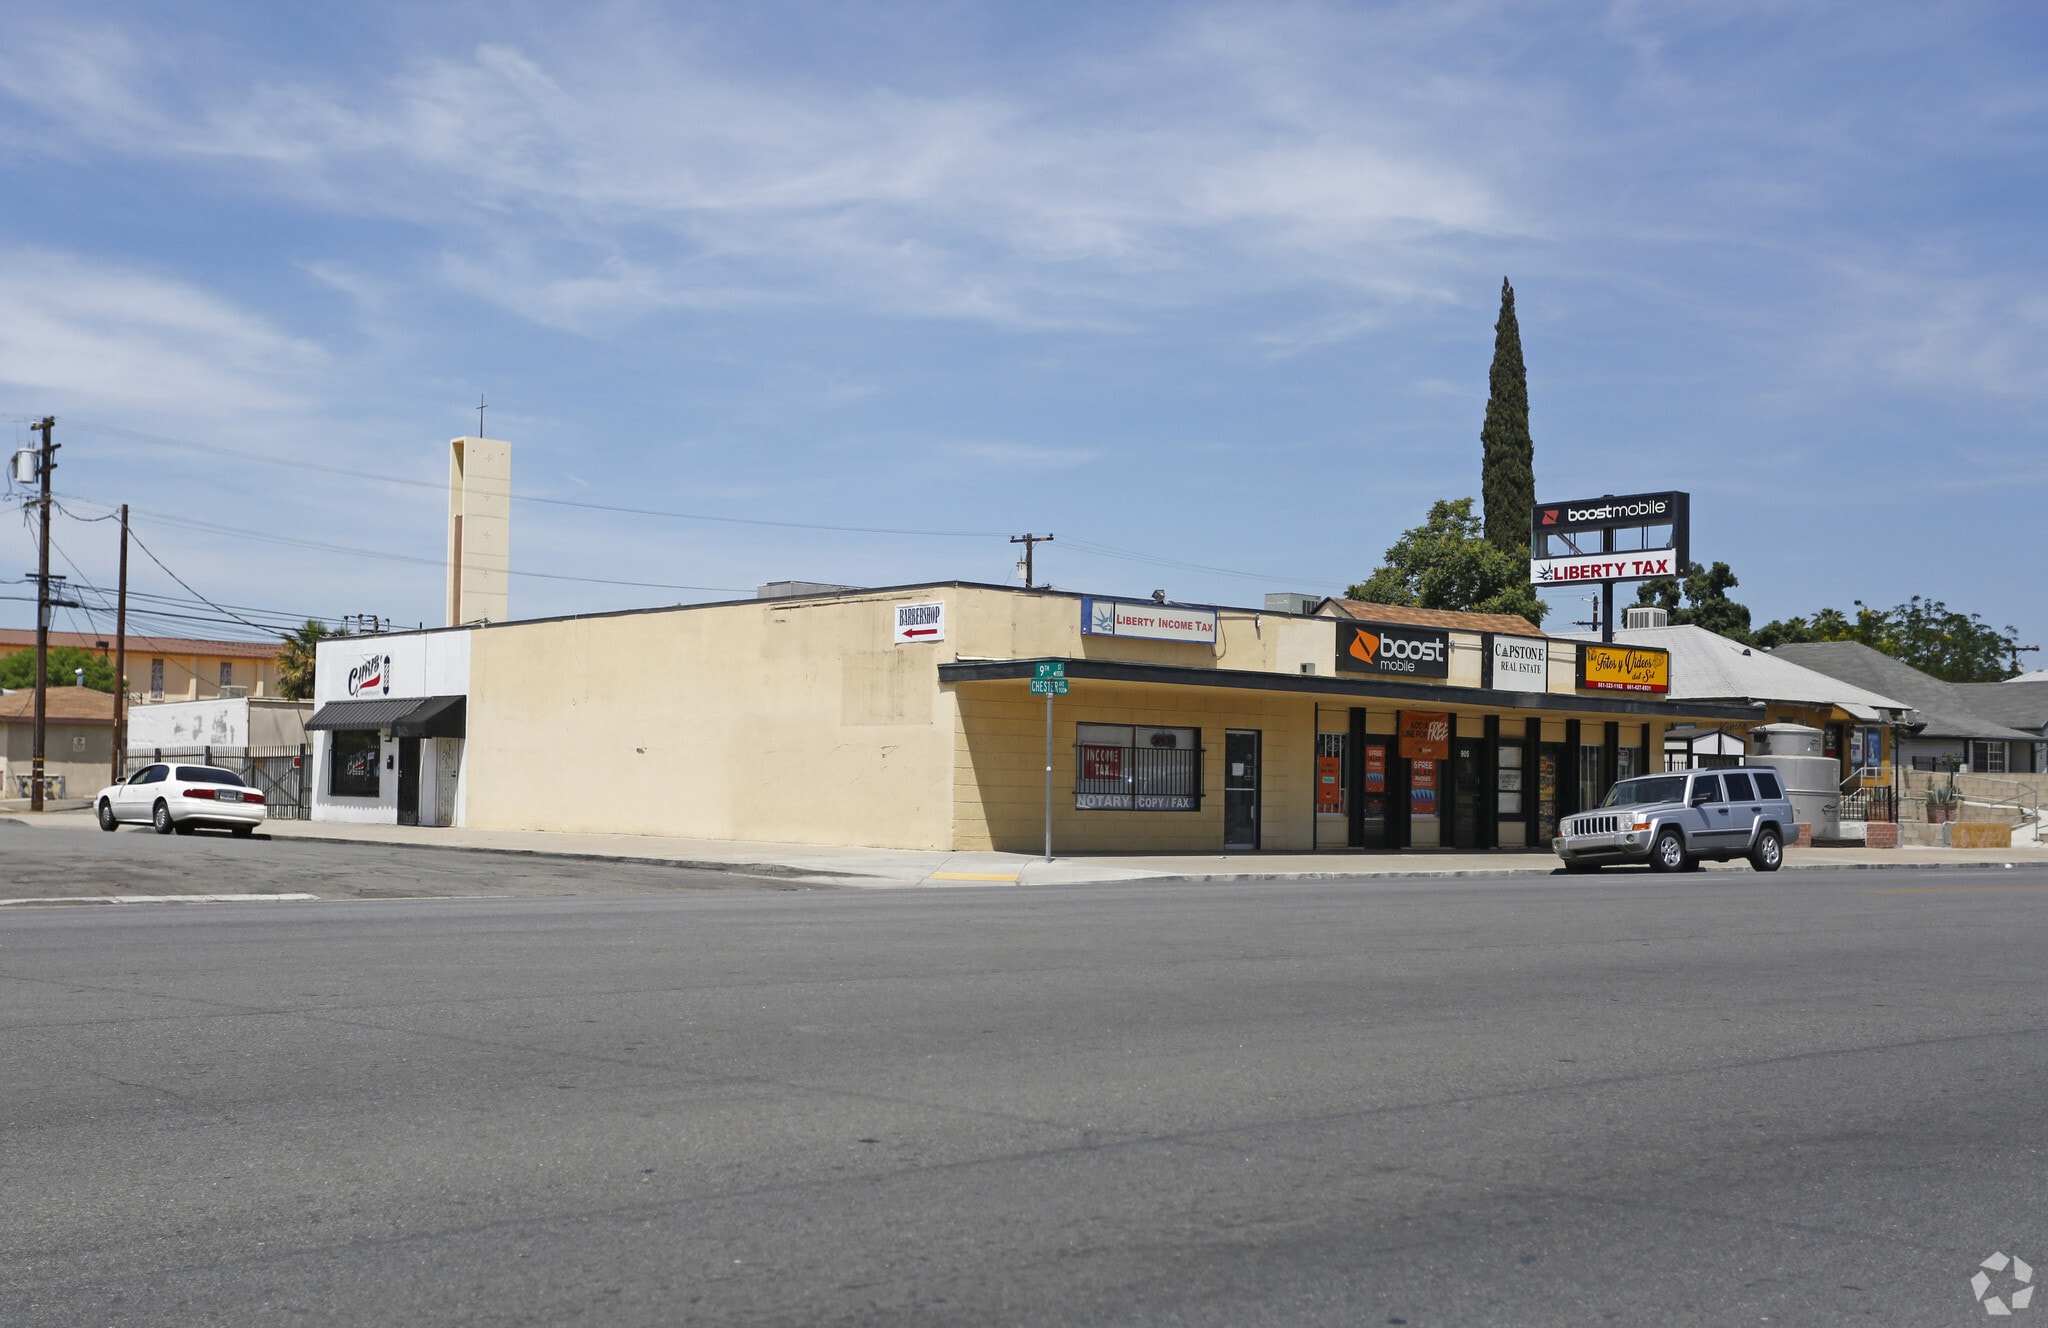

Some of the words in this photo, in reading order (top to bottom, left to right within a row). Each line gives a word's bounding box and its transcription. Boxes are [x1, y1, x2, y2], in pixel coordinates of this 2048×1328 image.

[1568, 500, 1666, 522] boostmobile
[1554, 562, 1626, 580] LIBERTY
[1632, 559, 1668, 575] TAX
[899, 606, 940, 626] BARBERSHOP
[1116, 614, 1155, 627] LIBERTY
[1158, 617, 1193, 631] INCOME
[1195, 621, 1213, 633] TAX
[1380, 633, 1444, 662] boost
[1380, 660, 1415, 672] mobile
[1501, 661, 1517, 672] REAL
[1519, 662, 1542, 674] ESTATE
[1596, 652, 1617, 672] Fotos
[1618, 660, 1623, 673] y
[1625, 649, 1653, 675] Videos
[1632, 672, 1642, 680] del
[1642, 669, 1655, 682] Sol
[1031, 680, 1058, 693] CHESTER
[1410, 721, 1422, 729] ADD
[1427, 721, 1449, 741] FREE
[1402, 730, 1414, 738] LINE
[1094, 763, 1110, 776] TAX
[1418, 761, 1433, 770] FREE
[1076, 795, 1130, 808] NOTARY
[1139, 796, 1163, 808] COPY
[1171, 797, 1189, 808] FAX
